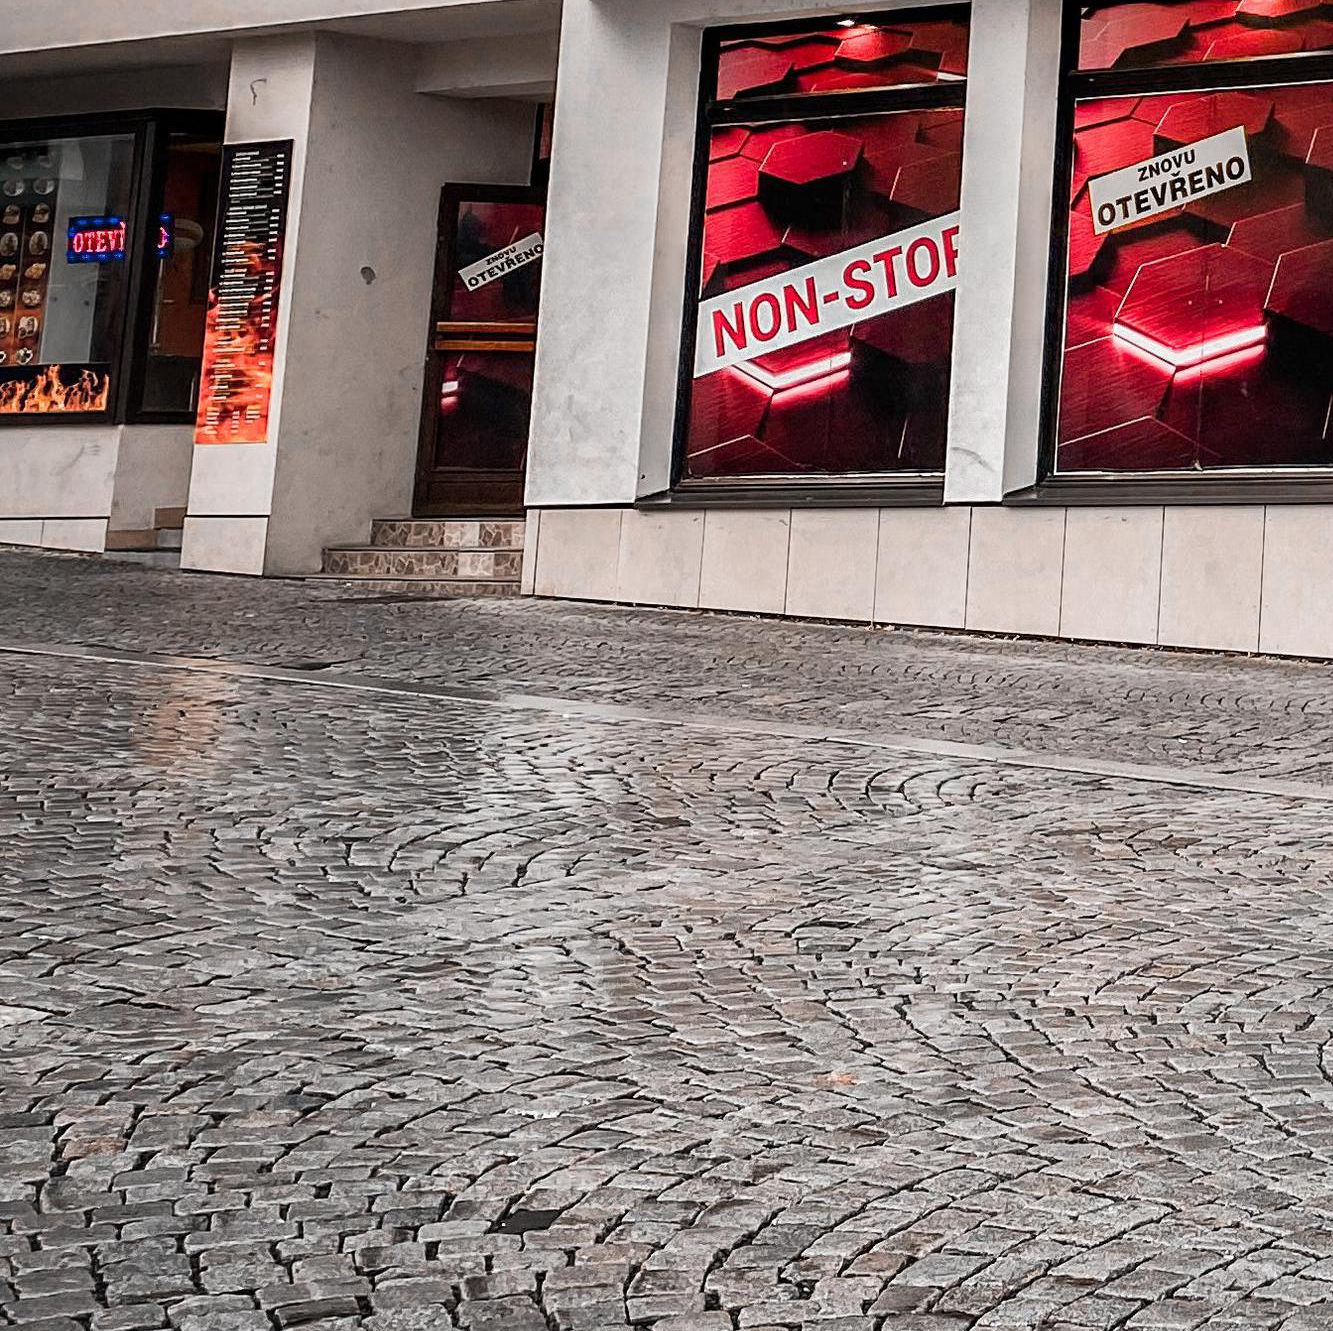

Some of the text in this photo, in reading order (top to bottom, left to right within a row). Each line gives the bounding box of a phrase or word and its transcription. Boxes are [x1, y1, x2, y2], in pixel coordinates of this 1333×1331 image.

[1137, 149, 1196, 183] ZNOVU
[1097, 156, 1245, 226] OTEVŘENO
[467, 243, 544, 288] OTEVŘENO
[485, 246, 517, 266] ZNOVU
